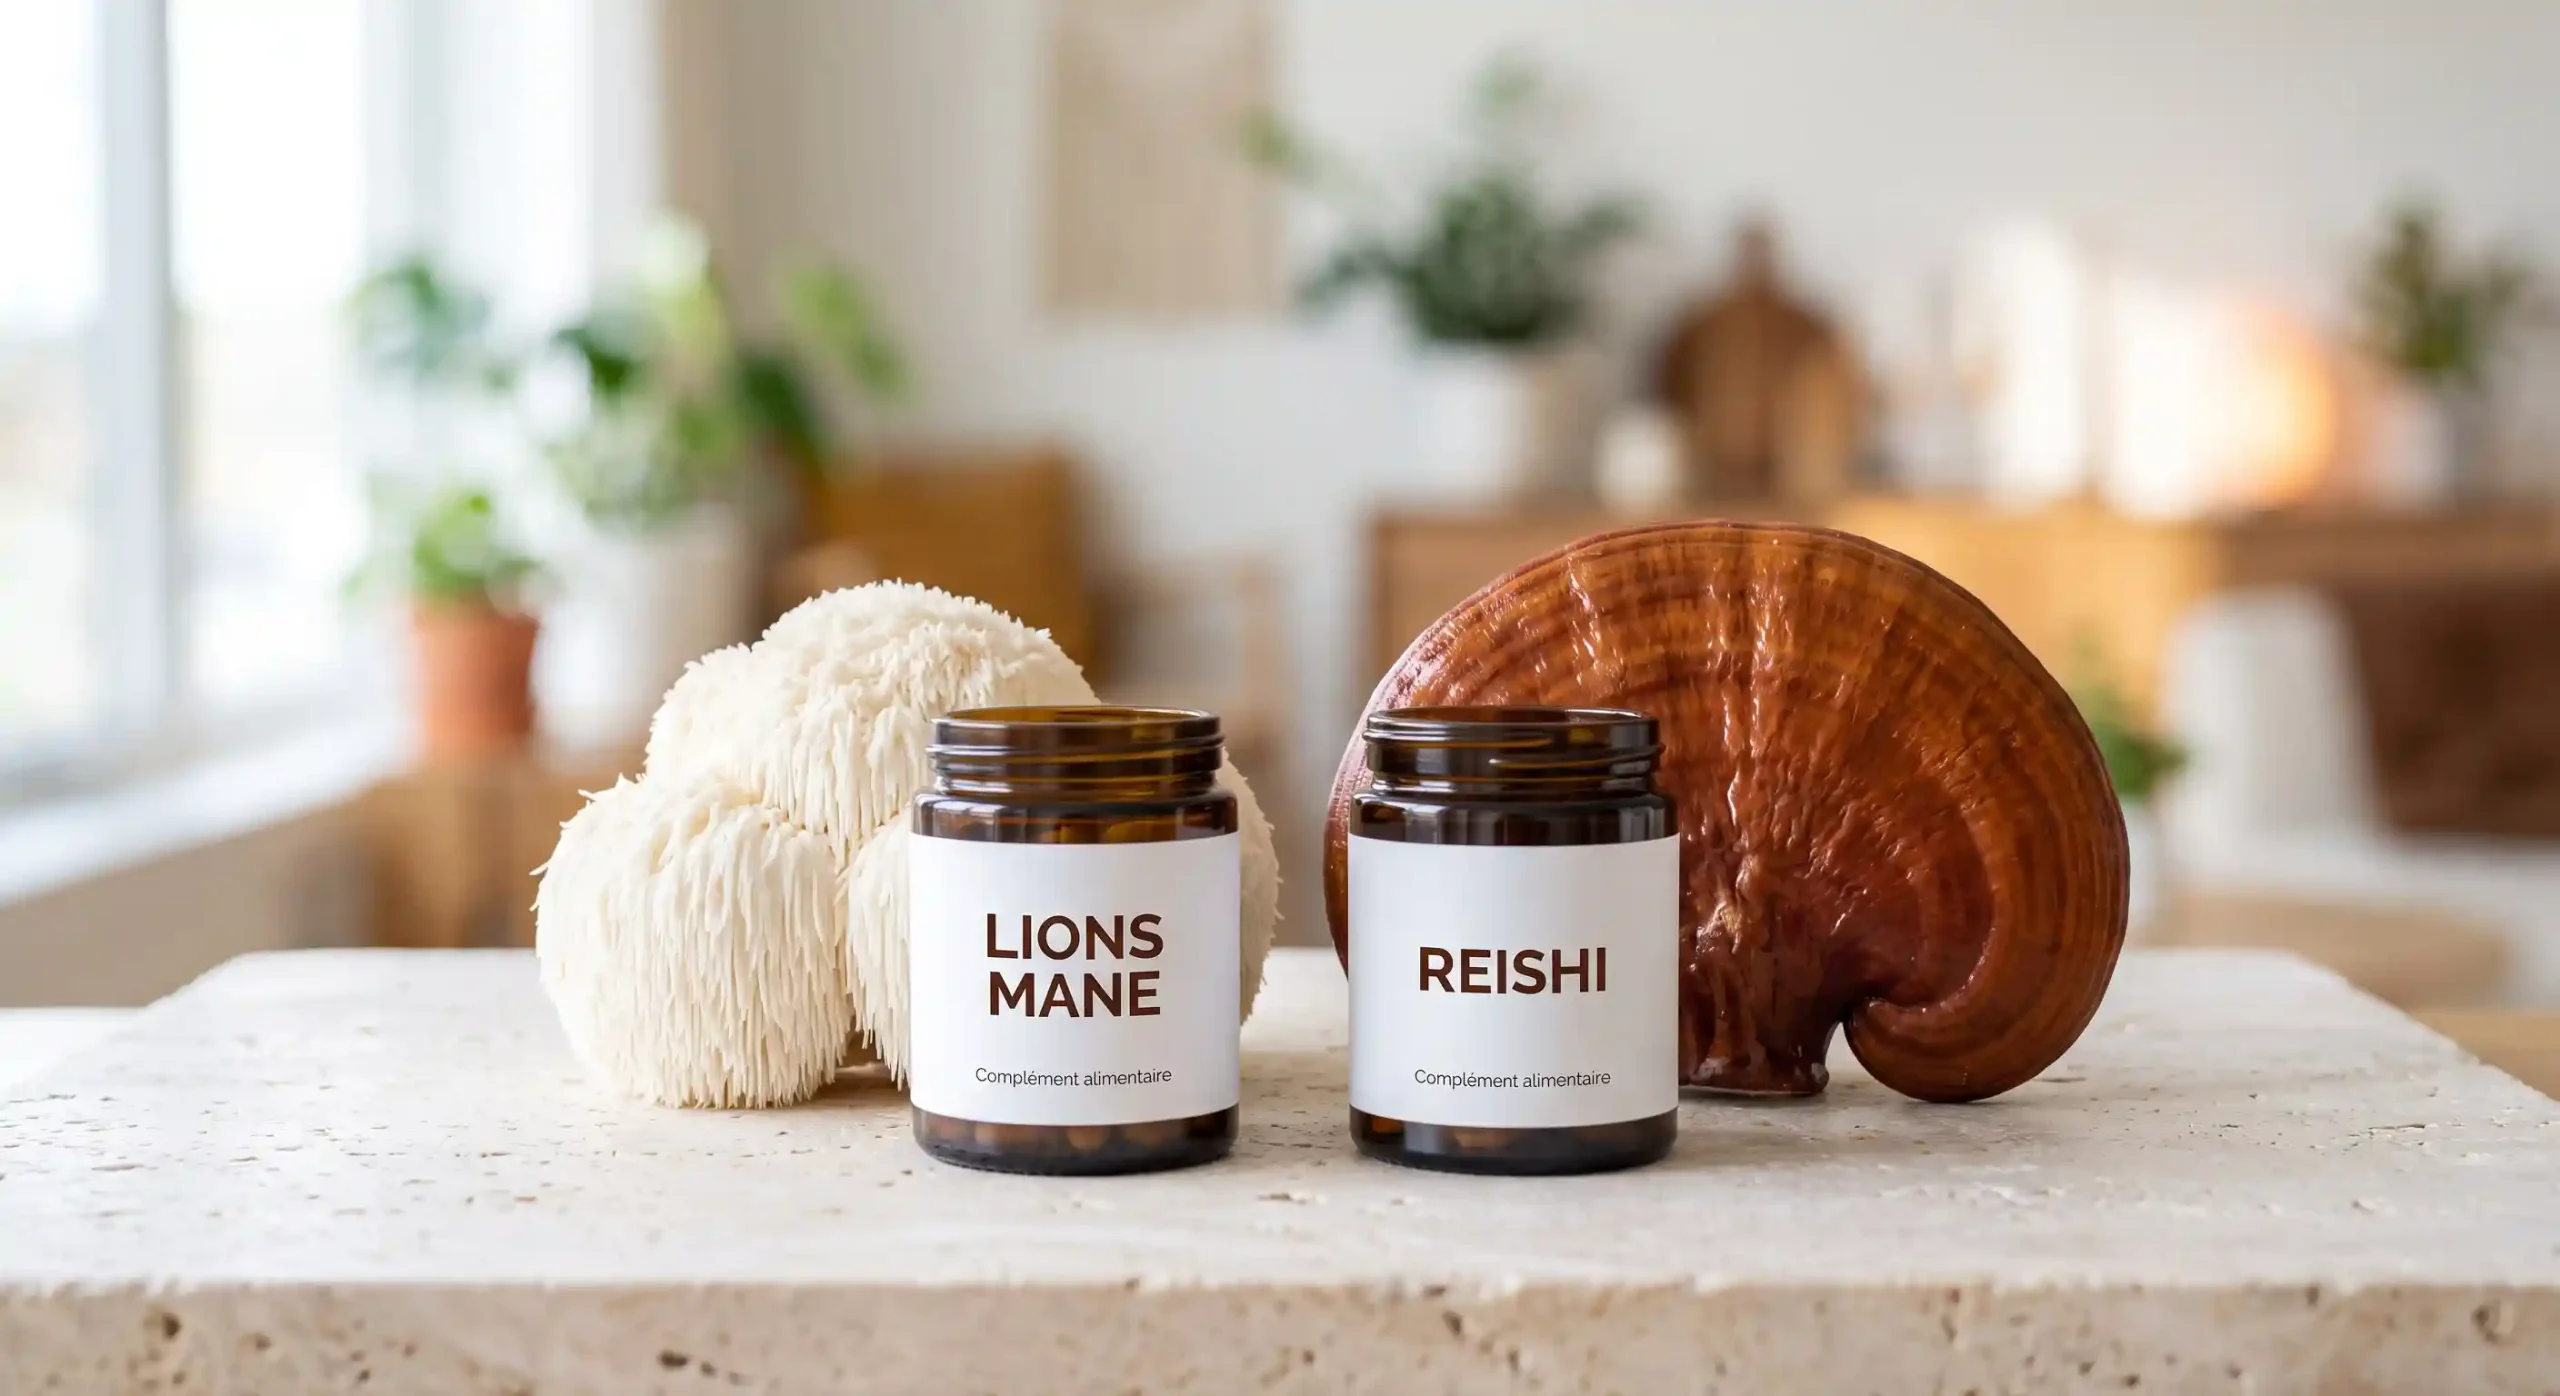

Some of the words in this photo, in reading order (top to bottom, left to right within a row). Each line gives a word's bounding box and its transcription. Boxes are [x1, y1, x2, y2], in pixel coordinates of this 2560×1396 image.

[986, 913, 1164, 961] LIONS
[989, 970, 1161, 1018] MANE
[1419, 946, 1607, 995] REISHI
[975, 1067, 1080, 1089] Complément
[1083, 1069, 1173, 1087] alimentaire
[1414, 1069, 1519, 1090] Complément
[1523, 1071, 1611, 1088] alimentaire
